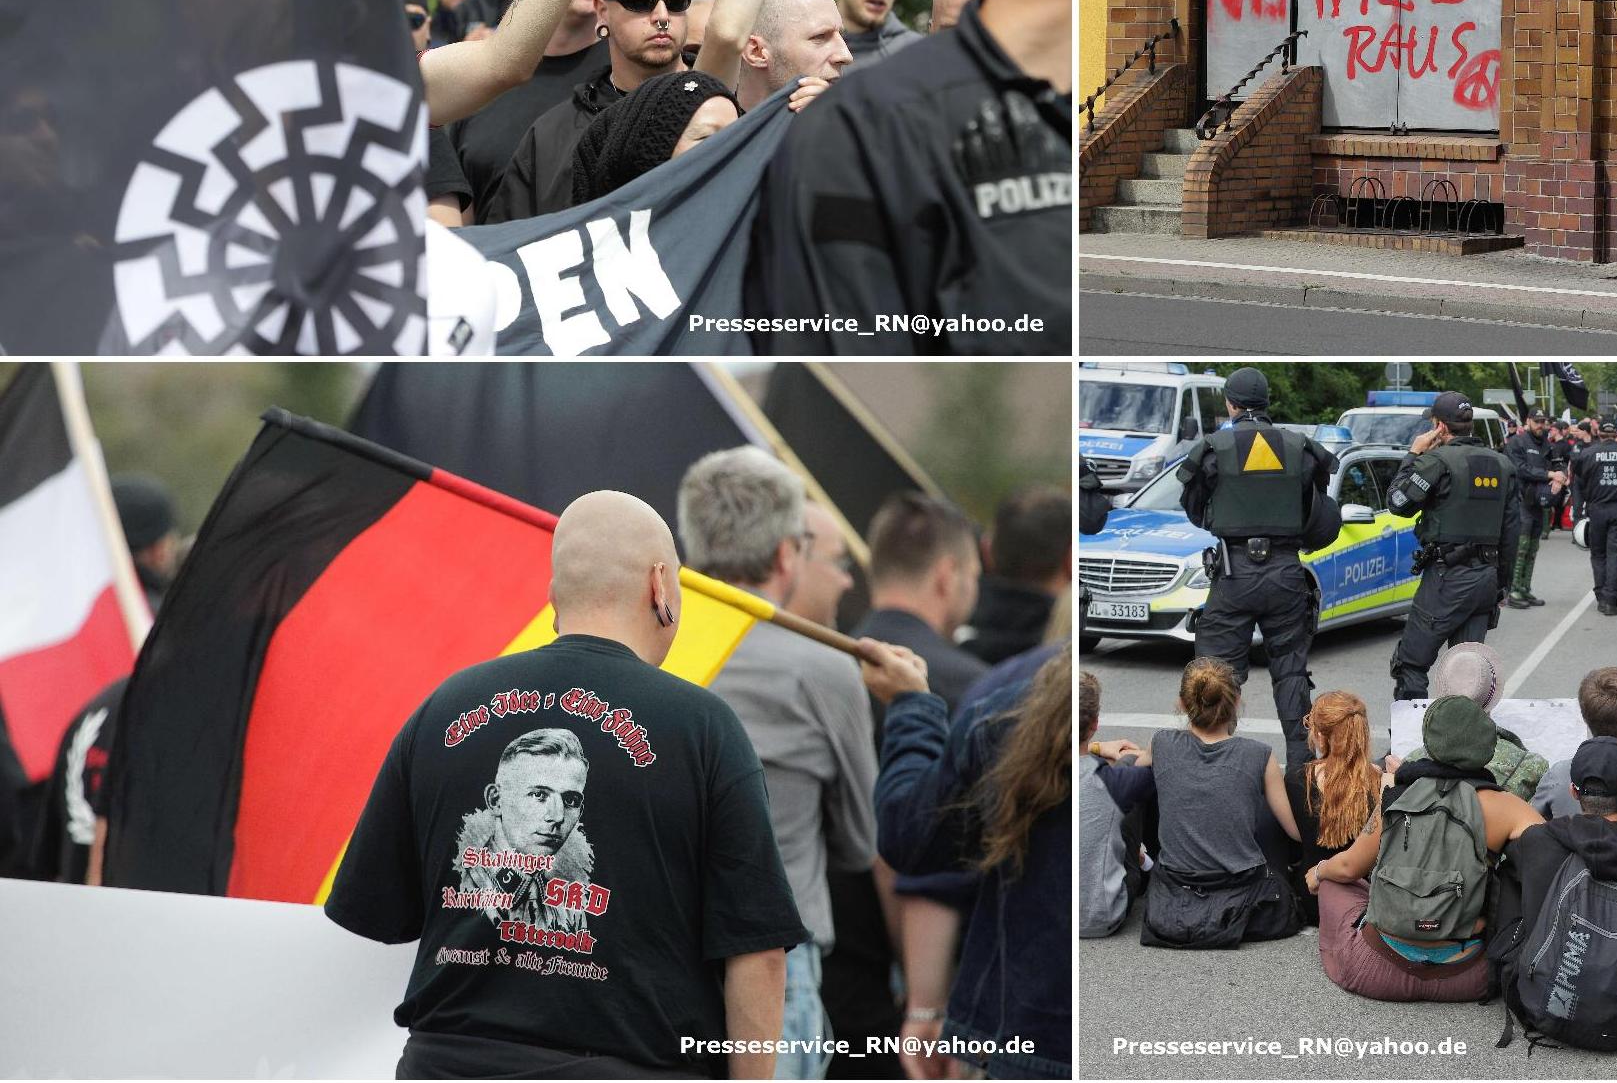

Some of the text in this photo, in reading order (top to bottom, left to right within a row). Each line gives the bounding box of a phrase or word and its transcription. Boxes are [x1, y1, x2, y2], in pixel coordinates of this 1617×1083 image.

[1343, 22, 1476, 79] RAUS
[1410, 472, 1431, 492] POLIZEI
[1345, 556, 1385, 585] POLIZEI
[1110, 604, 1146, 618] 33183
[445, 705, 490, 747] Eine
[560, 688, 608, 721] Eine
[1555, 930, 1590, 991] PUMA
